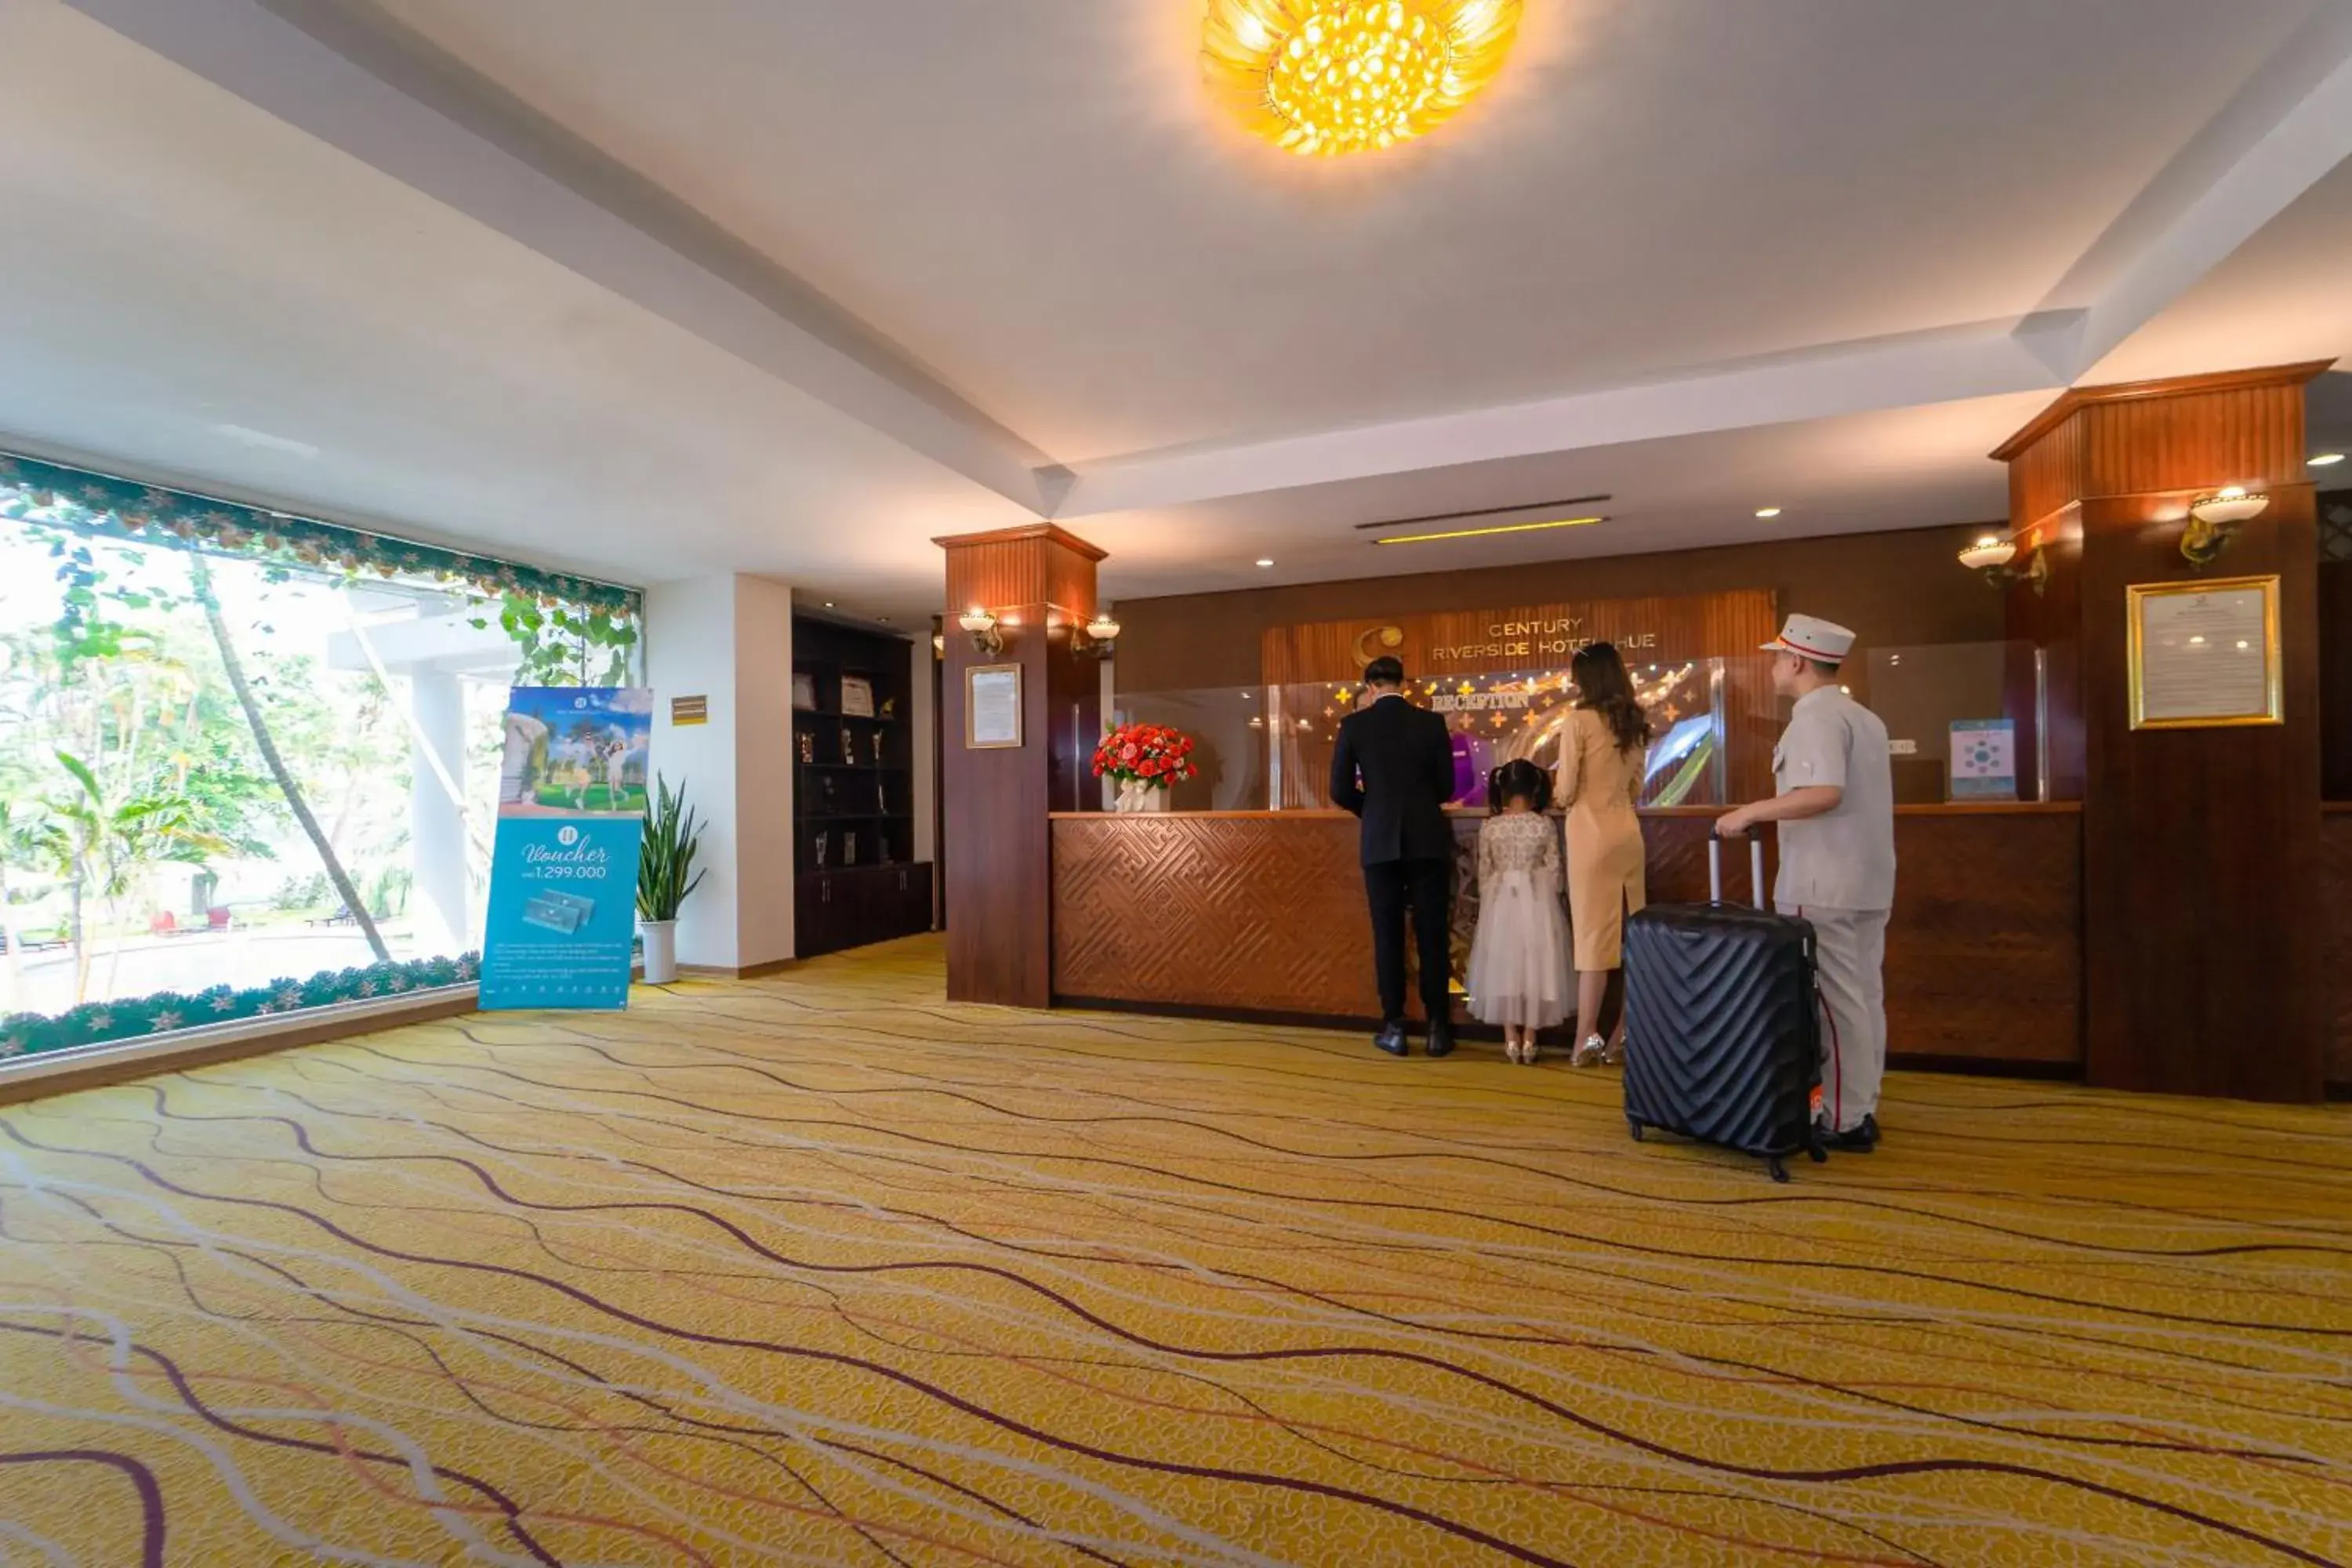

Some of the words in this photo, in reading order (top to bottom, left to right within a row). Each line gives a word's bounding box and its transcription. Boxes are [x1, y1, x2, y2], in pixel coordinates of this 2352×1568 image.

[1490, 618, 1581, 637] CENTURY
[1432, 642, 1530, 660] RIVERSIDE
[1615, 633, 1656, 650] HUE
[1431, 693, 1530, 712] RECEPTION
[521, 833, 612, 863] Voucher
[535, 866, 606, 879] 1.299.000
